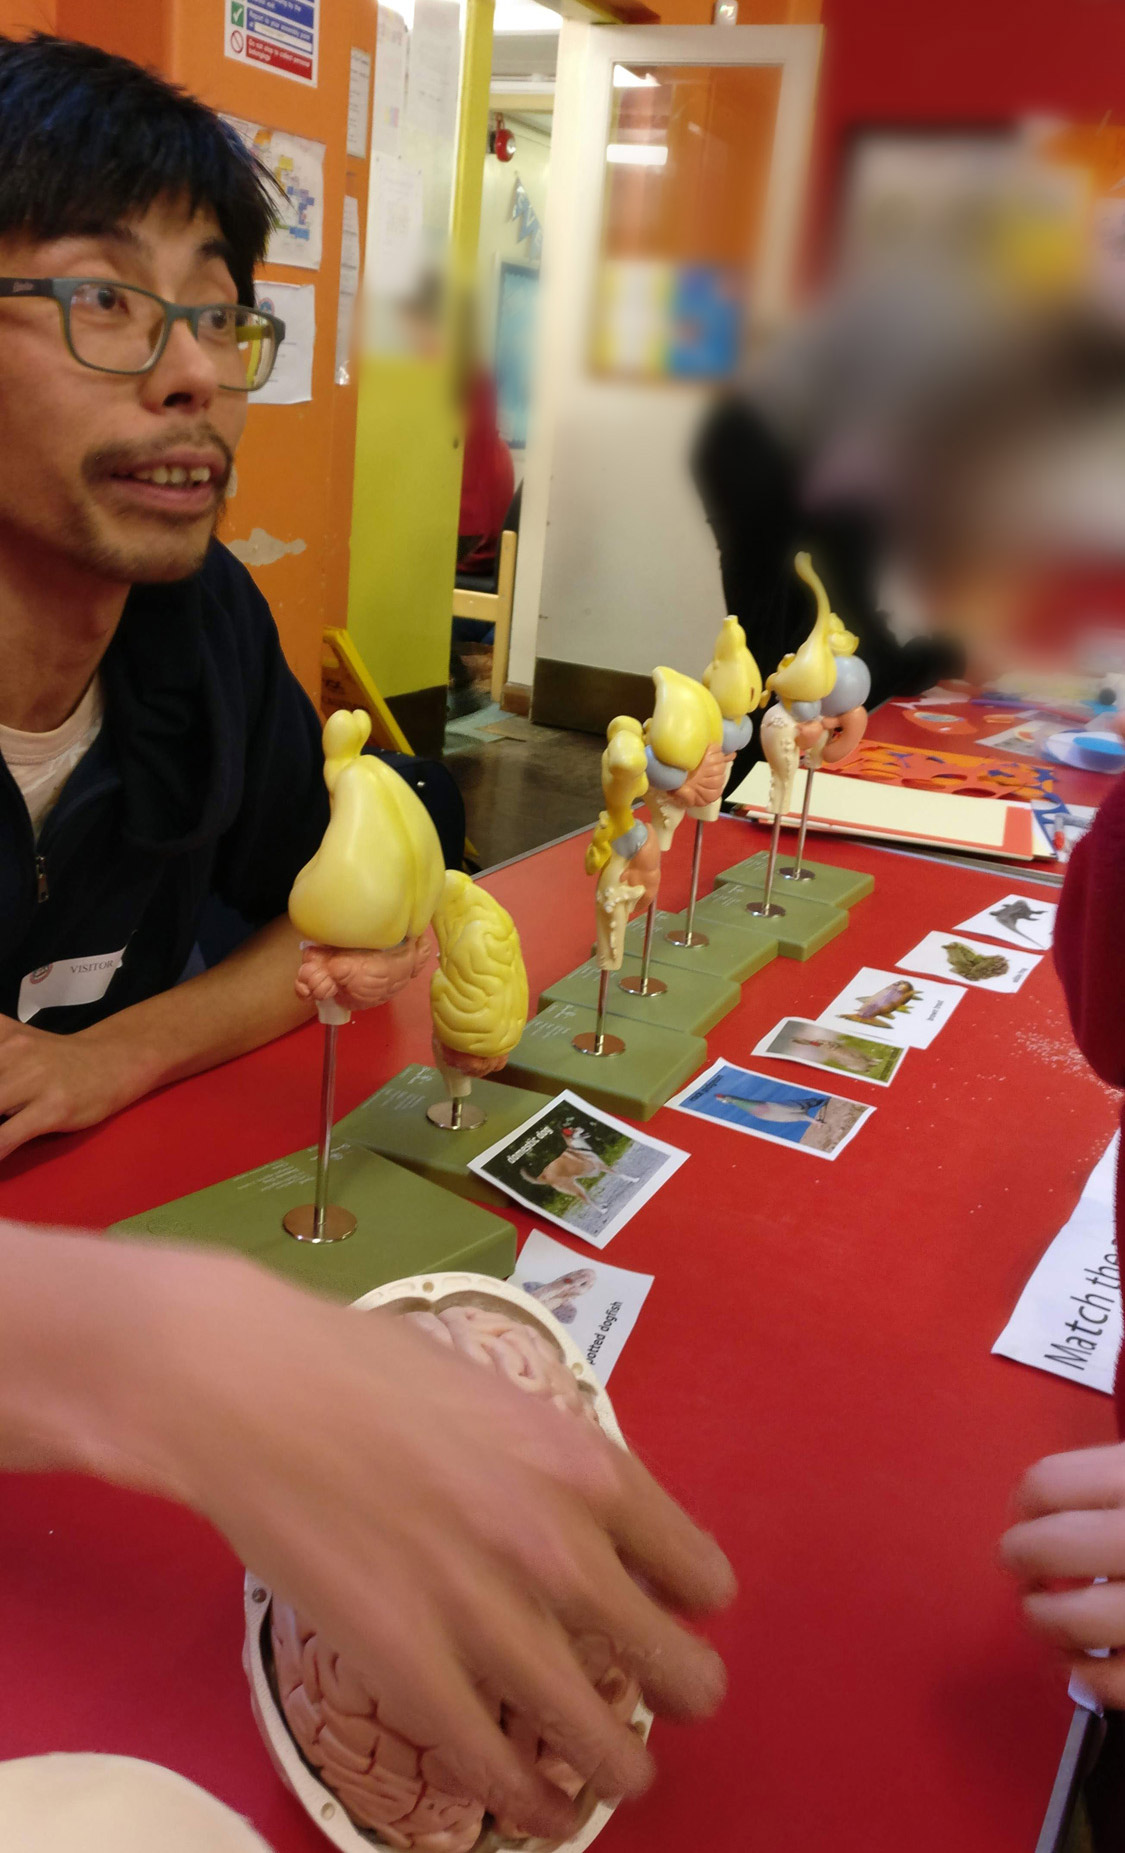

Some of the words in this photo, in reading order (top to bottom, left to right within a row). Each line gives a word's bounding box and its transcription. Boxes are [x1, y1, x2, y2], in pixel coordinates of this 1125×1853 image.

[69, 960, 114, 974] VISITOR
[506, 1137, 540, 1164] domestic
[535, 1125, 554, 1140] dog
[598, 1301, 623, 1332] dogfish
[1044, 1293, 1115, 1371] Match
